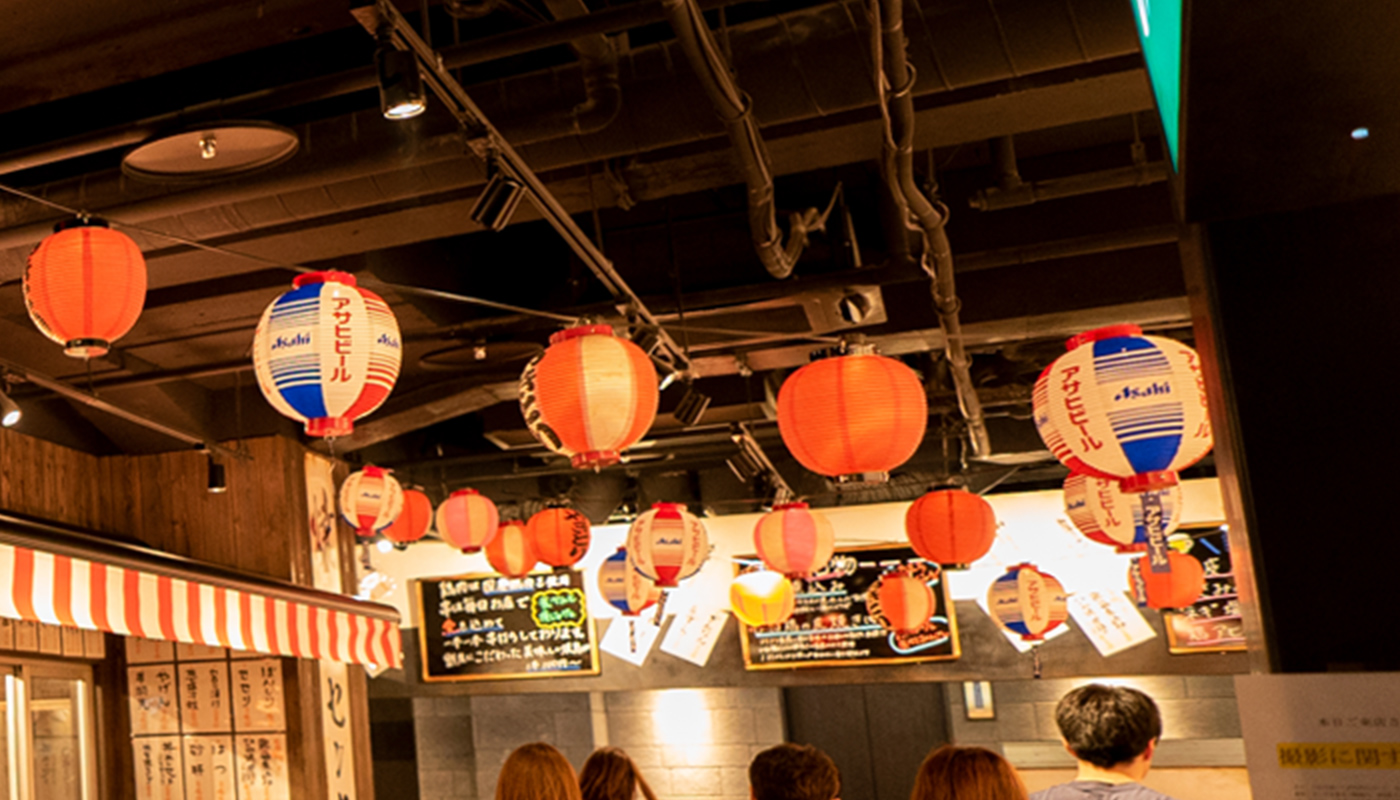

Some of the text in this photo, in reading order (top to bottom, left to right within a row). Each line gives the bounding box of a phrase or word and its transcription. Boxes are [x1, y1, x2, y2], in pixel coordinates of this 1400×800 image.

[271, 332, 311, 351] Asahi
[330, 297, 352, 383] アサヒビール
[1114, 381, 1171, 401] Asahi
[1061, 366, 1104, 452] アサヒビール
[211, 744, 227, 776] はつ
